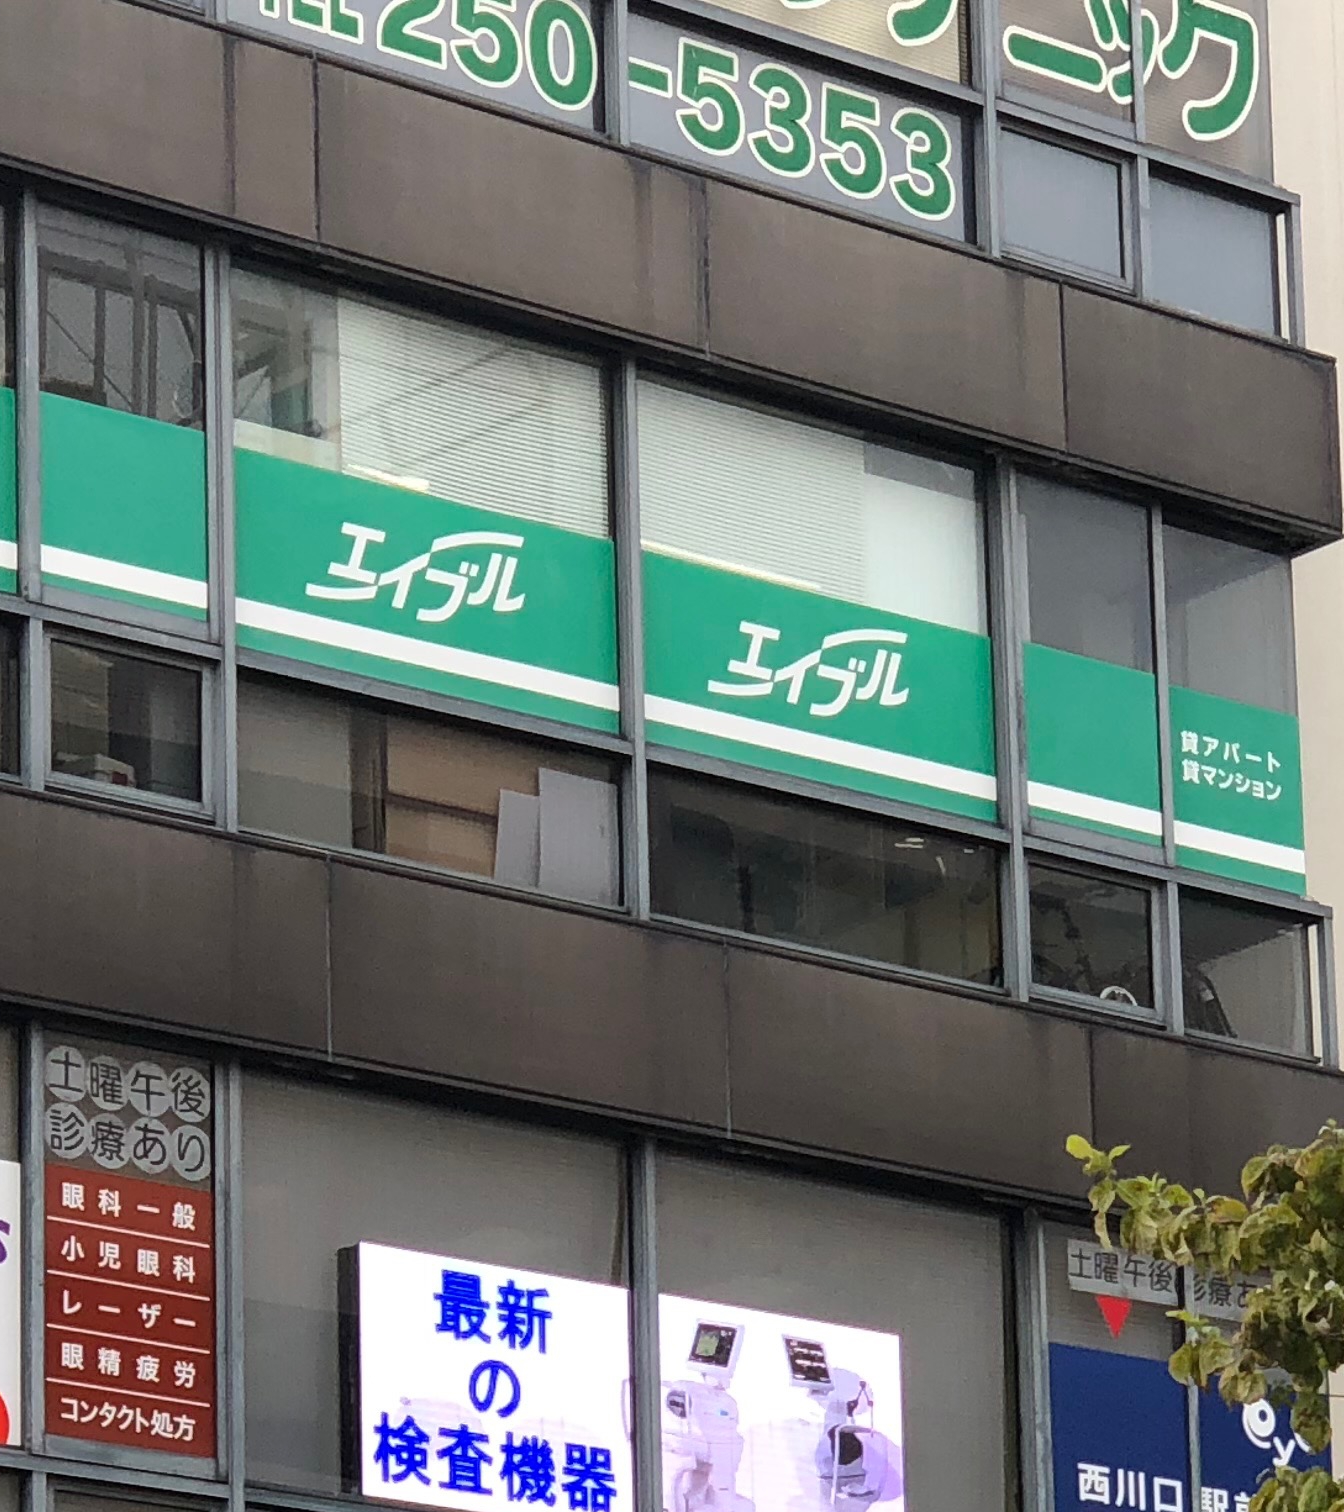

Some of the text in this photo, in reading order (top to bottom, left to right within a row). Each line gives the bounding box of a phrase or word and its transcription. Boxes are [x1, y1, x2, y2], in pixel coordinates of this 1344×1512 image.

[304, 520, 526, 623] エイブル
[707, 619, 910, 717] エイブル
[1179, 729, 1282, 774] 貸アパート
[1180, 757, 1283, 801] 貸マンション
[47, 1048, 208, 1120] 土曜午後
[47, 1106, 208, 1176] 診療あり
[61, 1181, 197, 1232] 眼科一般
[61, 1234, 197, 1284] 小児眼科
[61, 1288, 197, 1330] レーザー
[433, 1268, 552, 1355] 最新
[61, 1342, 197, 1389] 眼精疲労
[468, 1359, 522, 1418] の
[60, 1396, 197, 1442] コンタクト処方
